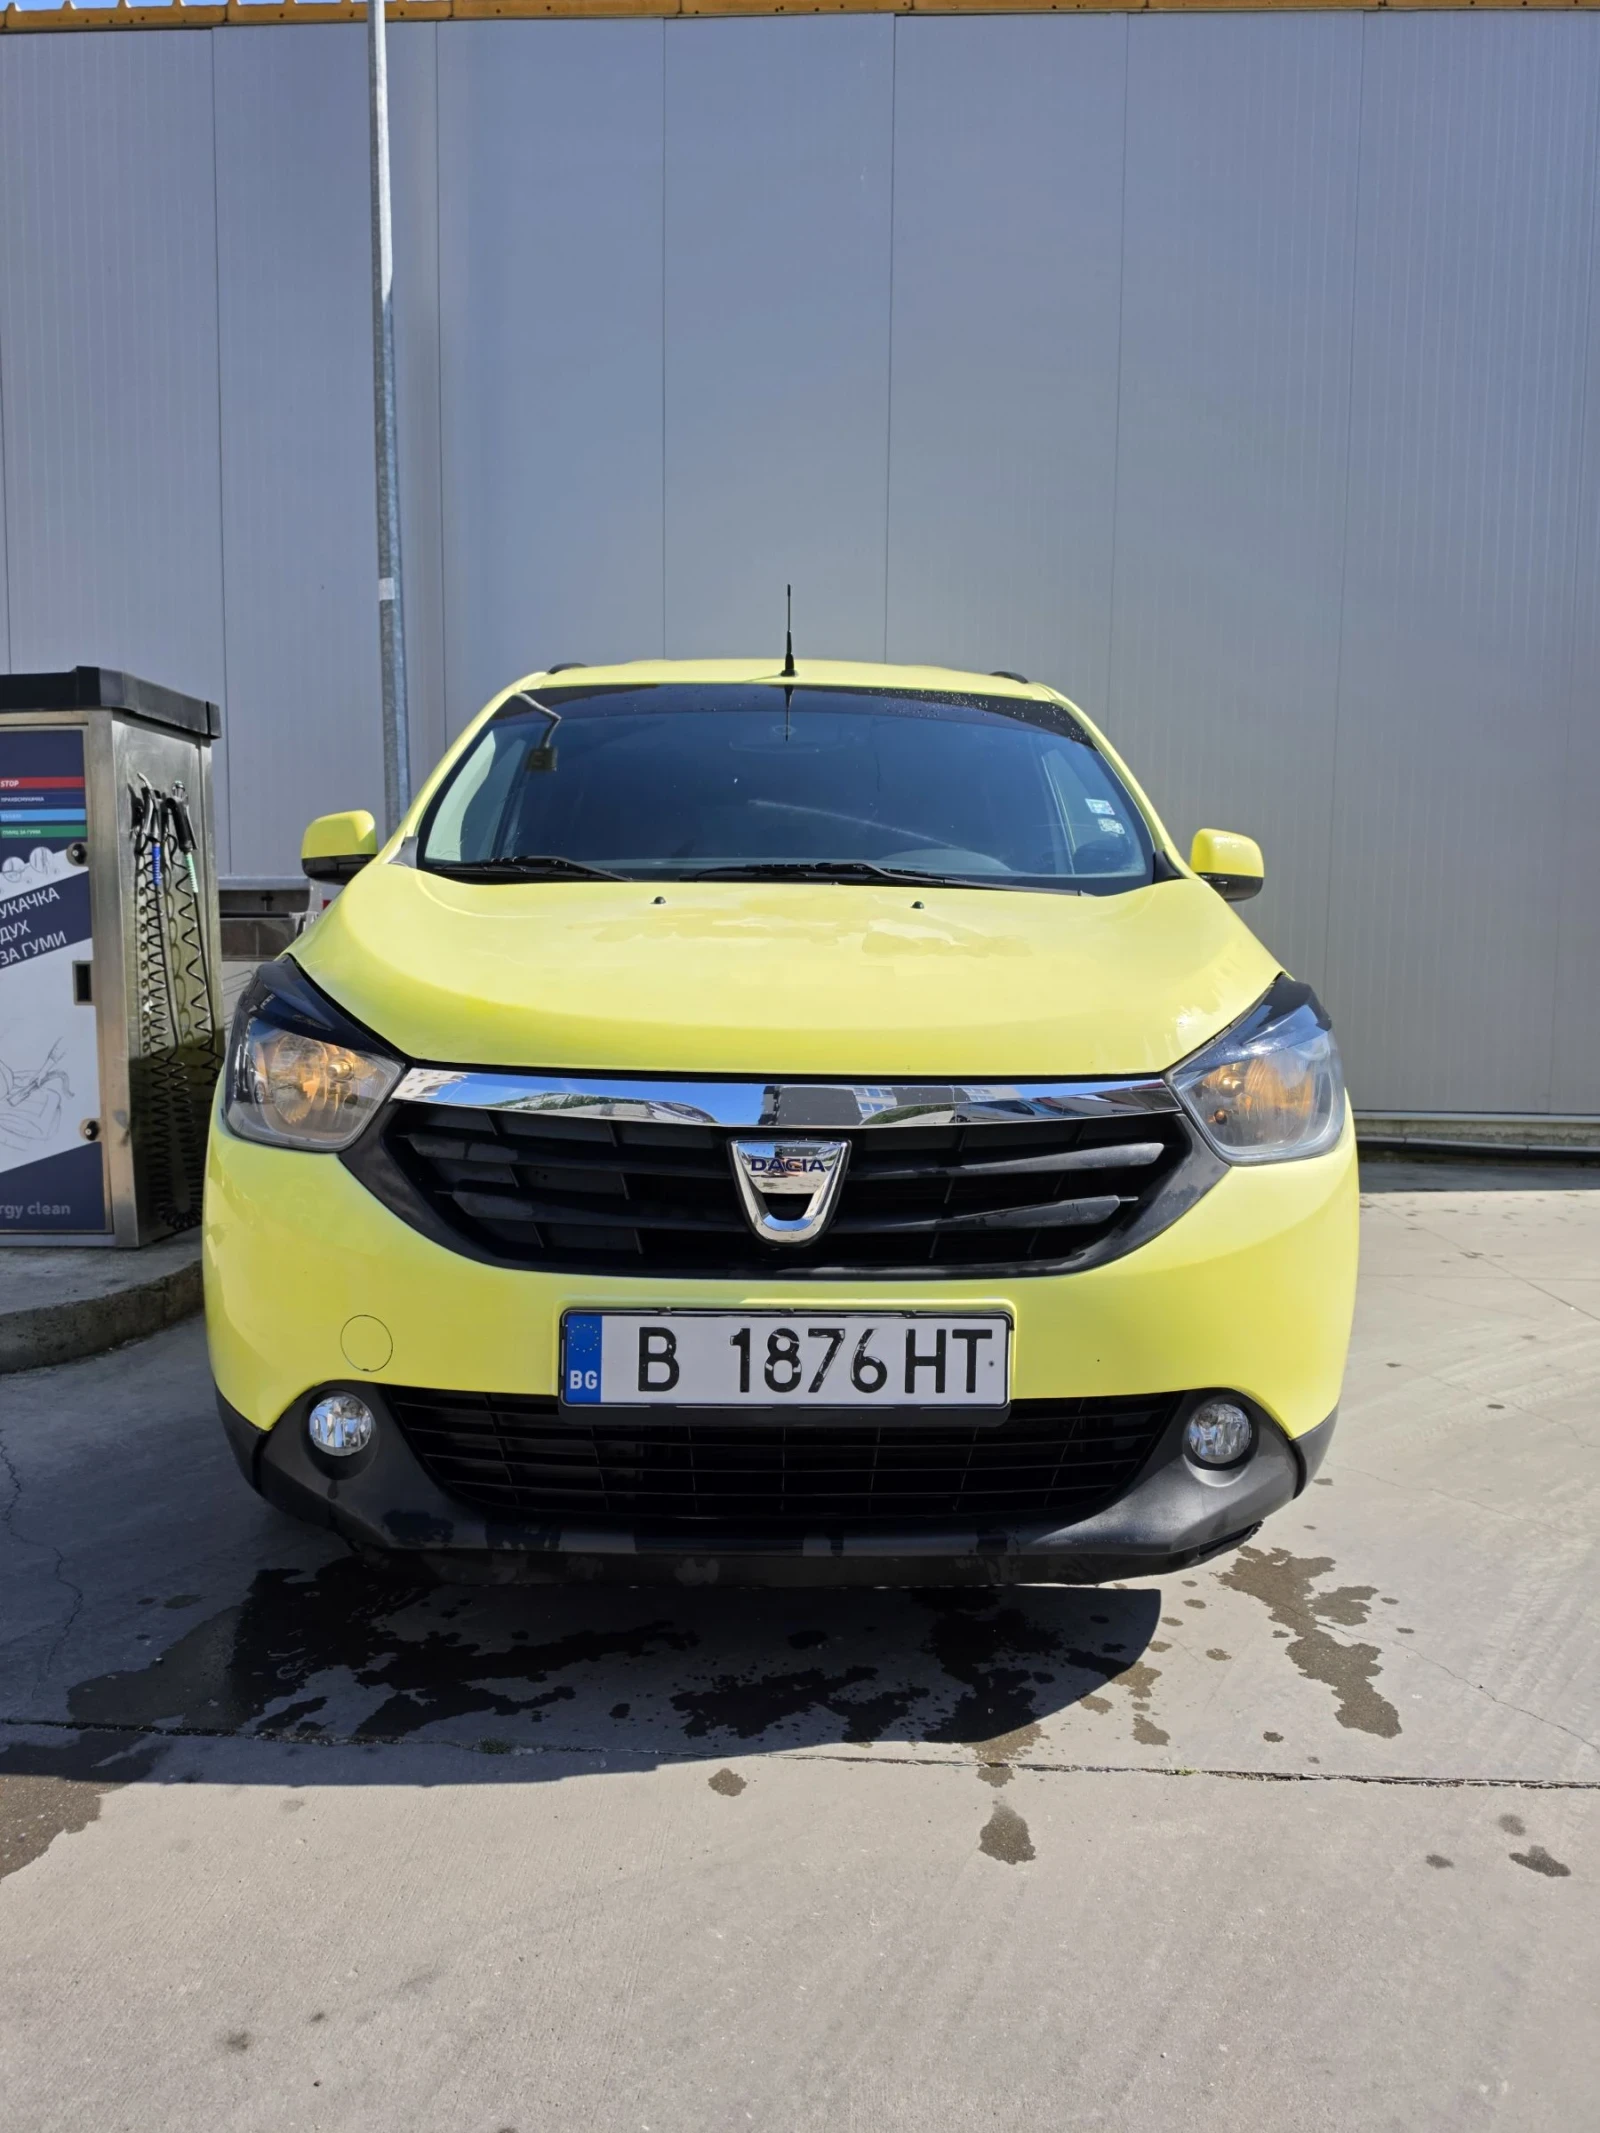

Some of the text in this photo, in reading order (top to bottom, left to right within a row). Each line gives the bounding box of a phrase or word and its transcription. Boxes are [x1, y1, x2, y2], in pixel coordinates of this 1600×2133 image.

[0, 780, 20, 788] STOP
[0, 930, 67, 966] ЗА ГУМИ
[751, 1158, 826, 1172] DACIA
[27, 1201, 71, 1215] clean
[637, 1326, 993, 1394] B 1876 HT
[569, 1370, 598, 1390] BG
